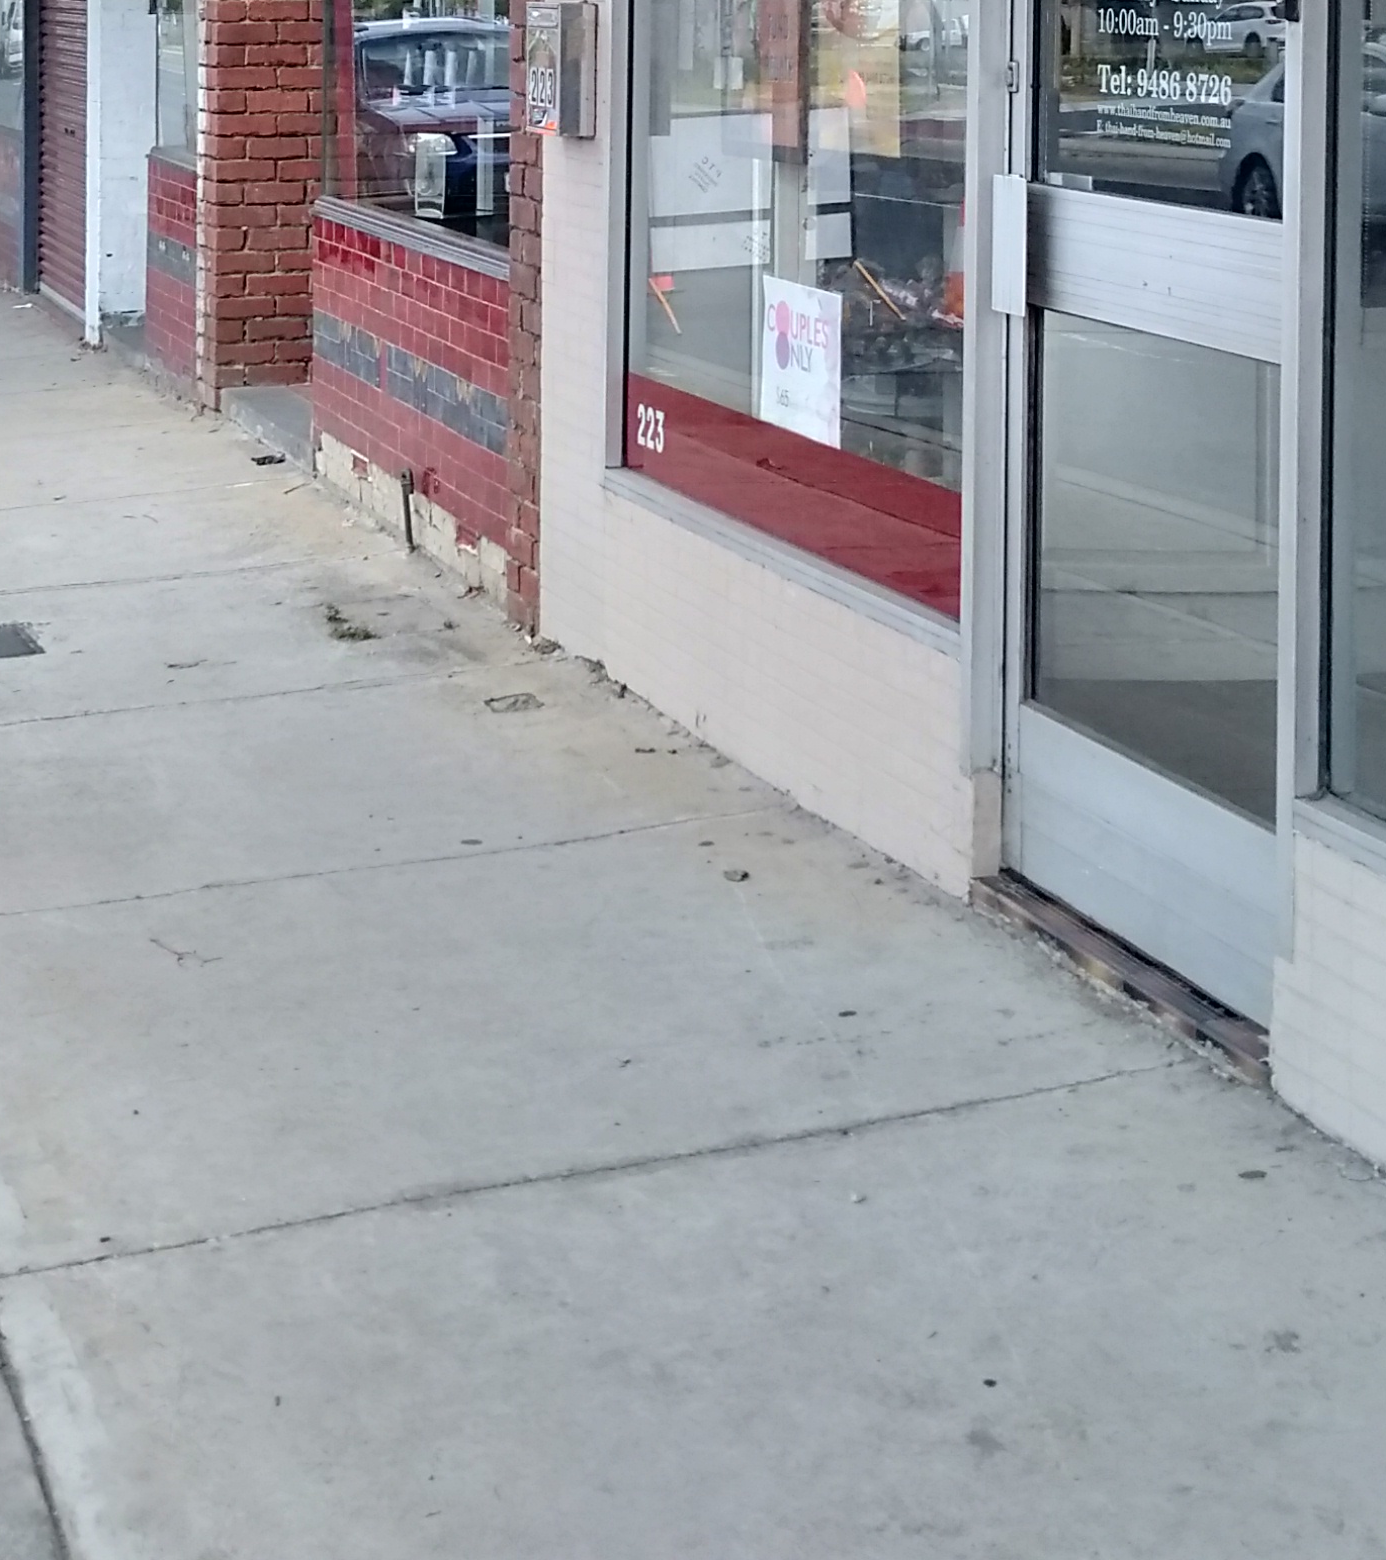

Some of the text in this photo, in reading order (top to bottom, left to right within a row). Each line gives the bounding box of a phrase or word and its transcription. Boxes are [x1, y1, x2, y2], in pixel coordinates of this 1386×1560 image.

[1098, 7, 1159, 37] 10:00am
[1173, 10, 1233, 46] 9:30pm
[530, 68, 554, 107] 223
[1097, 63, 1232, 106] Tel: 9486 8726
[636, 403, 665, 454] 223
